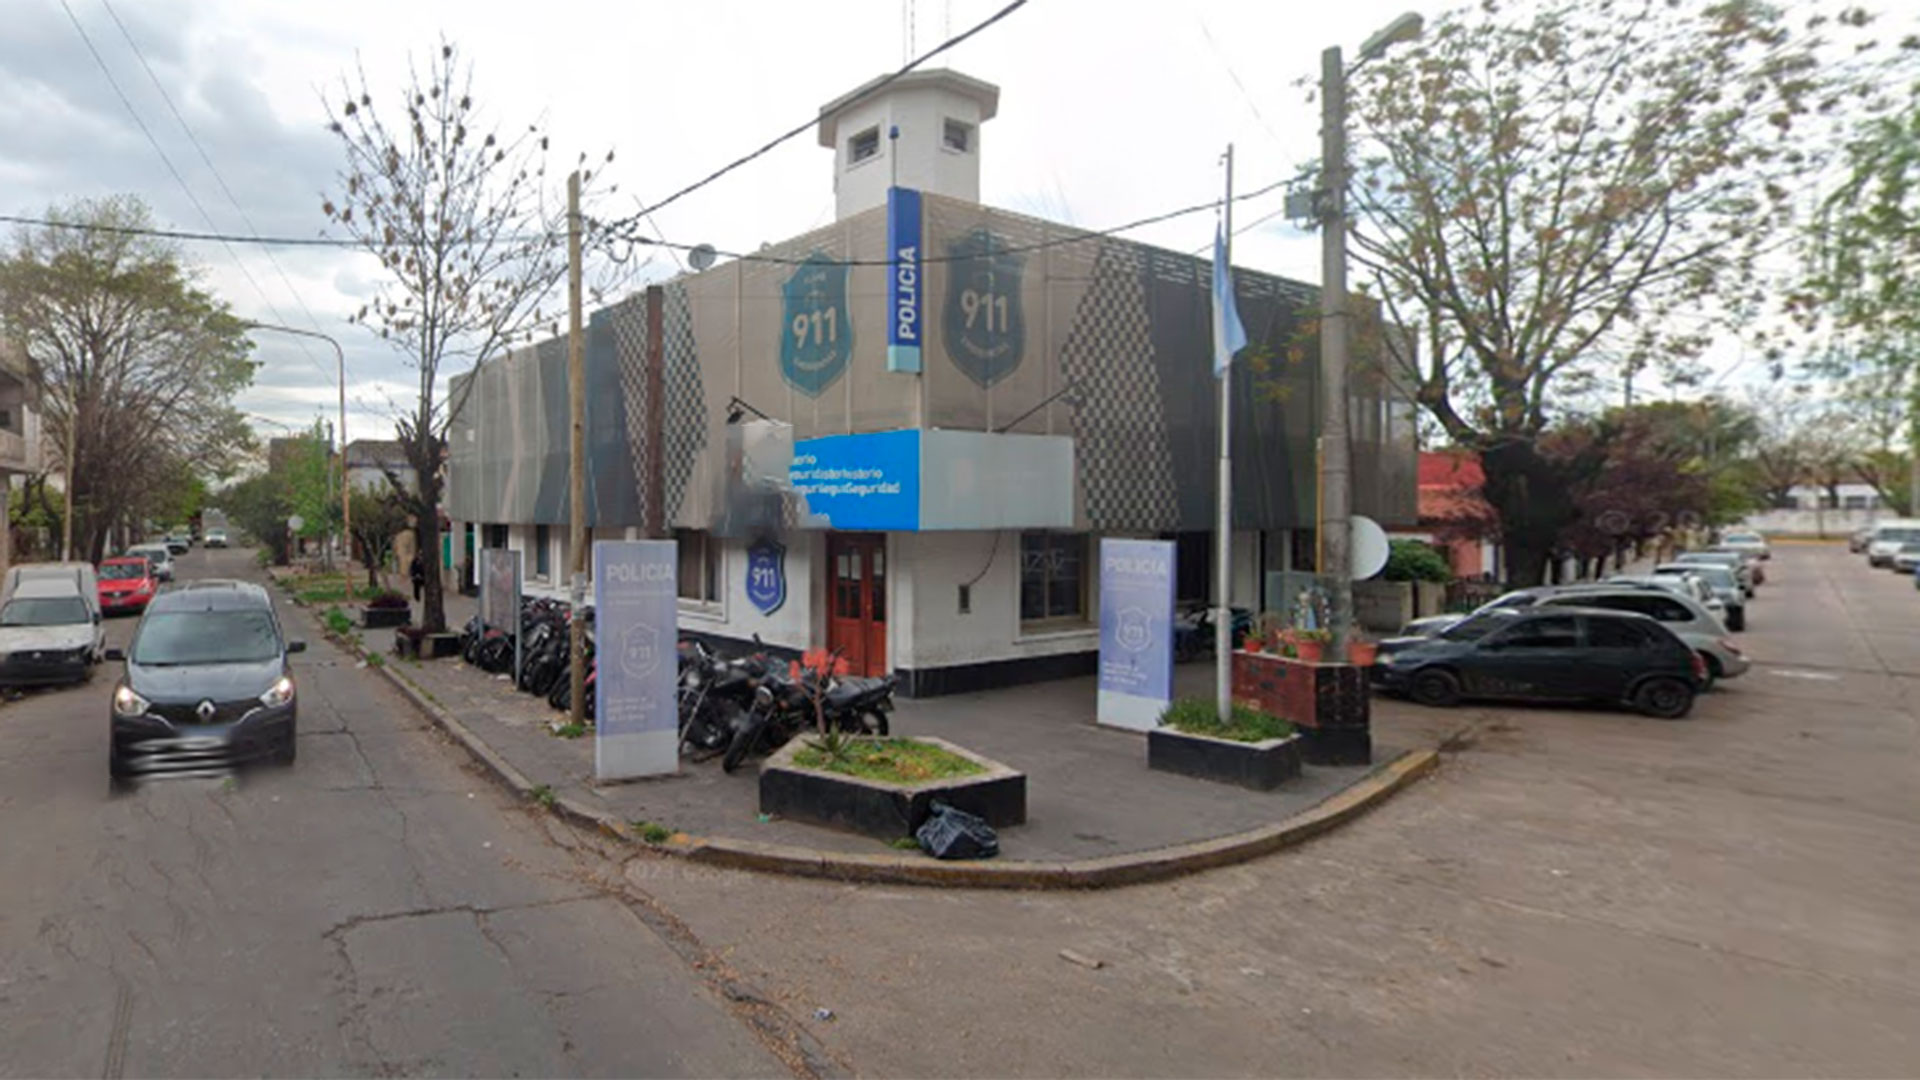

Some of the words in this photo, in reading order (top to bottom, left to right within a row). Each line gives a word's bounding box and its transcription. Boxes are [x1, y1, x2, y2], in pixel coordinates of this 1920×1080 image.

[897, 247, 916, 340] POLICIA
[960, 289, 1007, 333] 911
[792, 306, 837, 349] 911
[605, 563, 674, 583] POLICIA
[751, 567, 776, 588] 911
